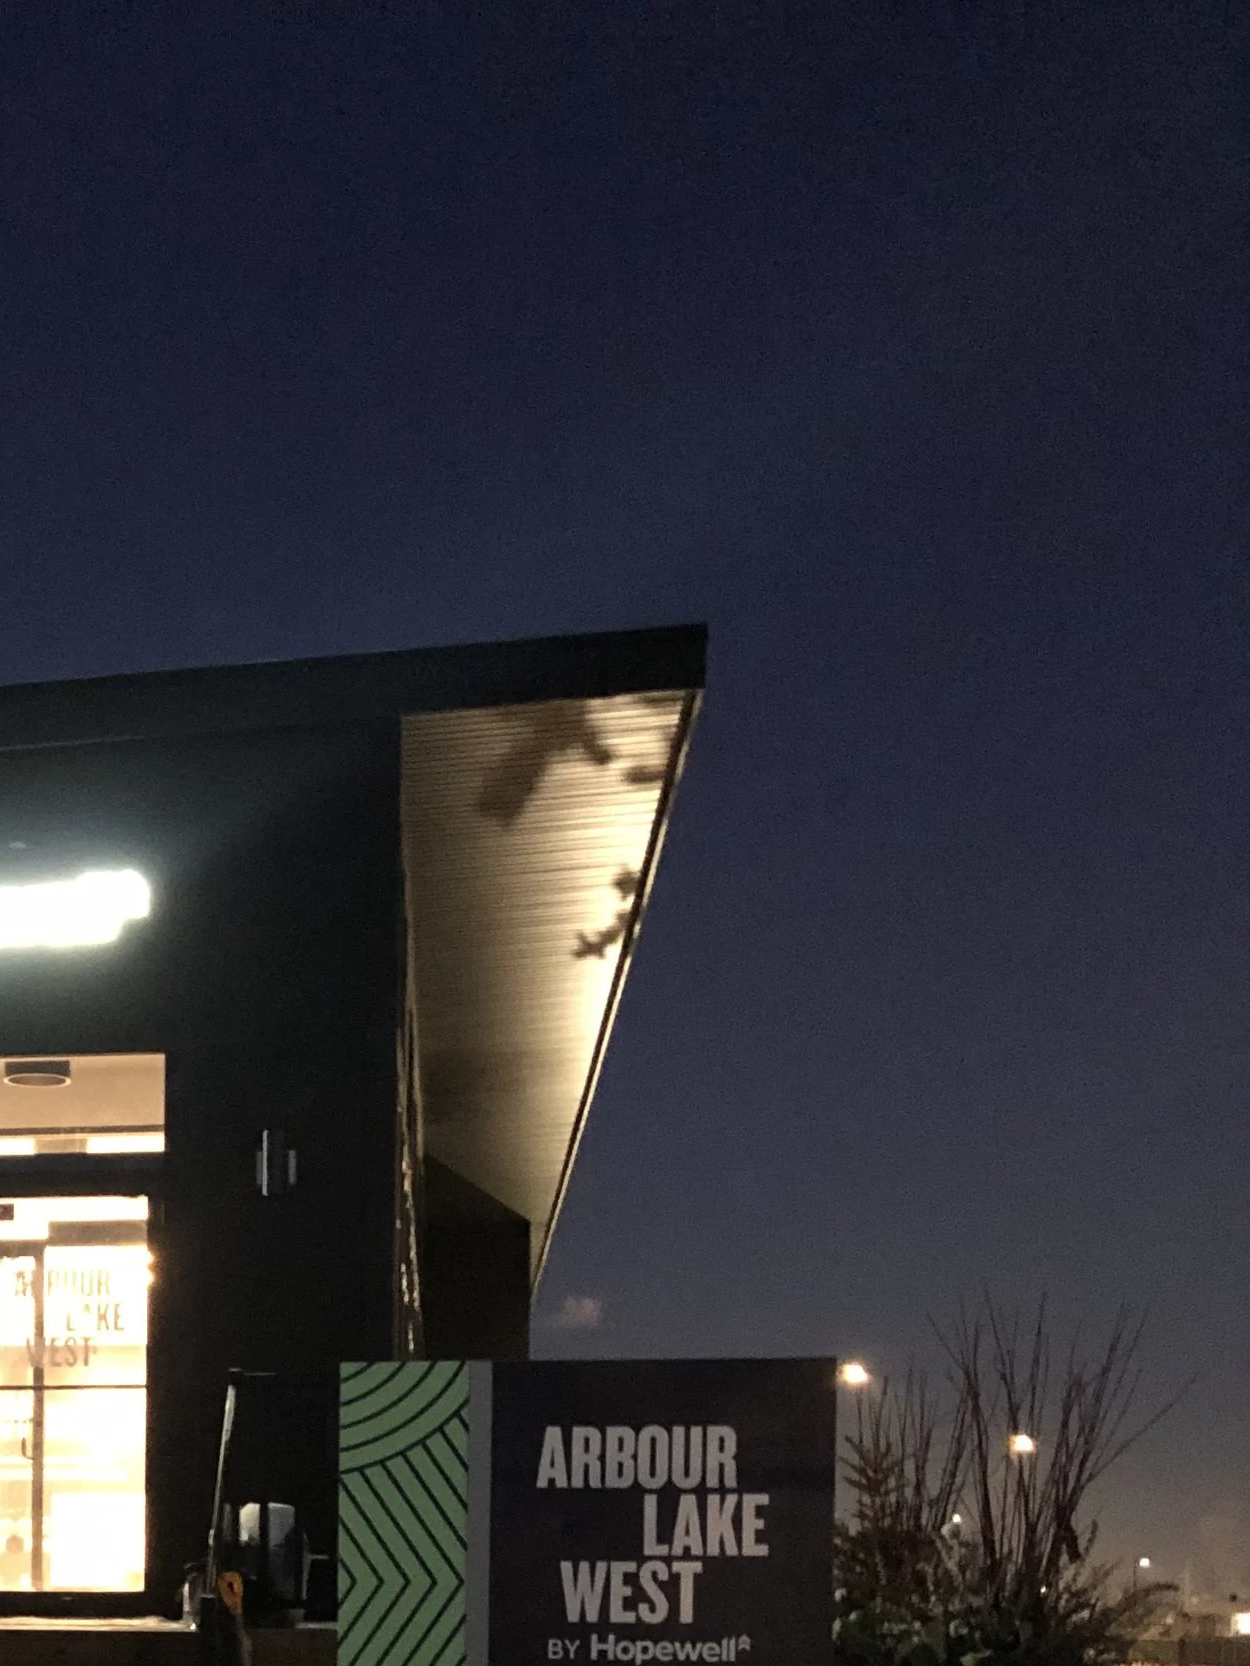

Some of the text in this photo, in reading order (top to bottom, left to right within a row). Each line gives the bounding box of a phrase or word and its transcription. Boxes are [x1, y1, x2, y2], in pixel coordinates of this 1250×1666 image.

[537, 1424, 738, 1489] ARBOUR
[644, 1492, 769, 1557] LAKE
[560, 1561, 703, 1624] WEST
[548, 1633, 736, 1665] BY Hopewell
